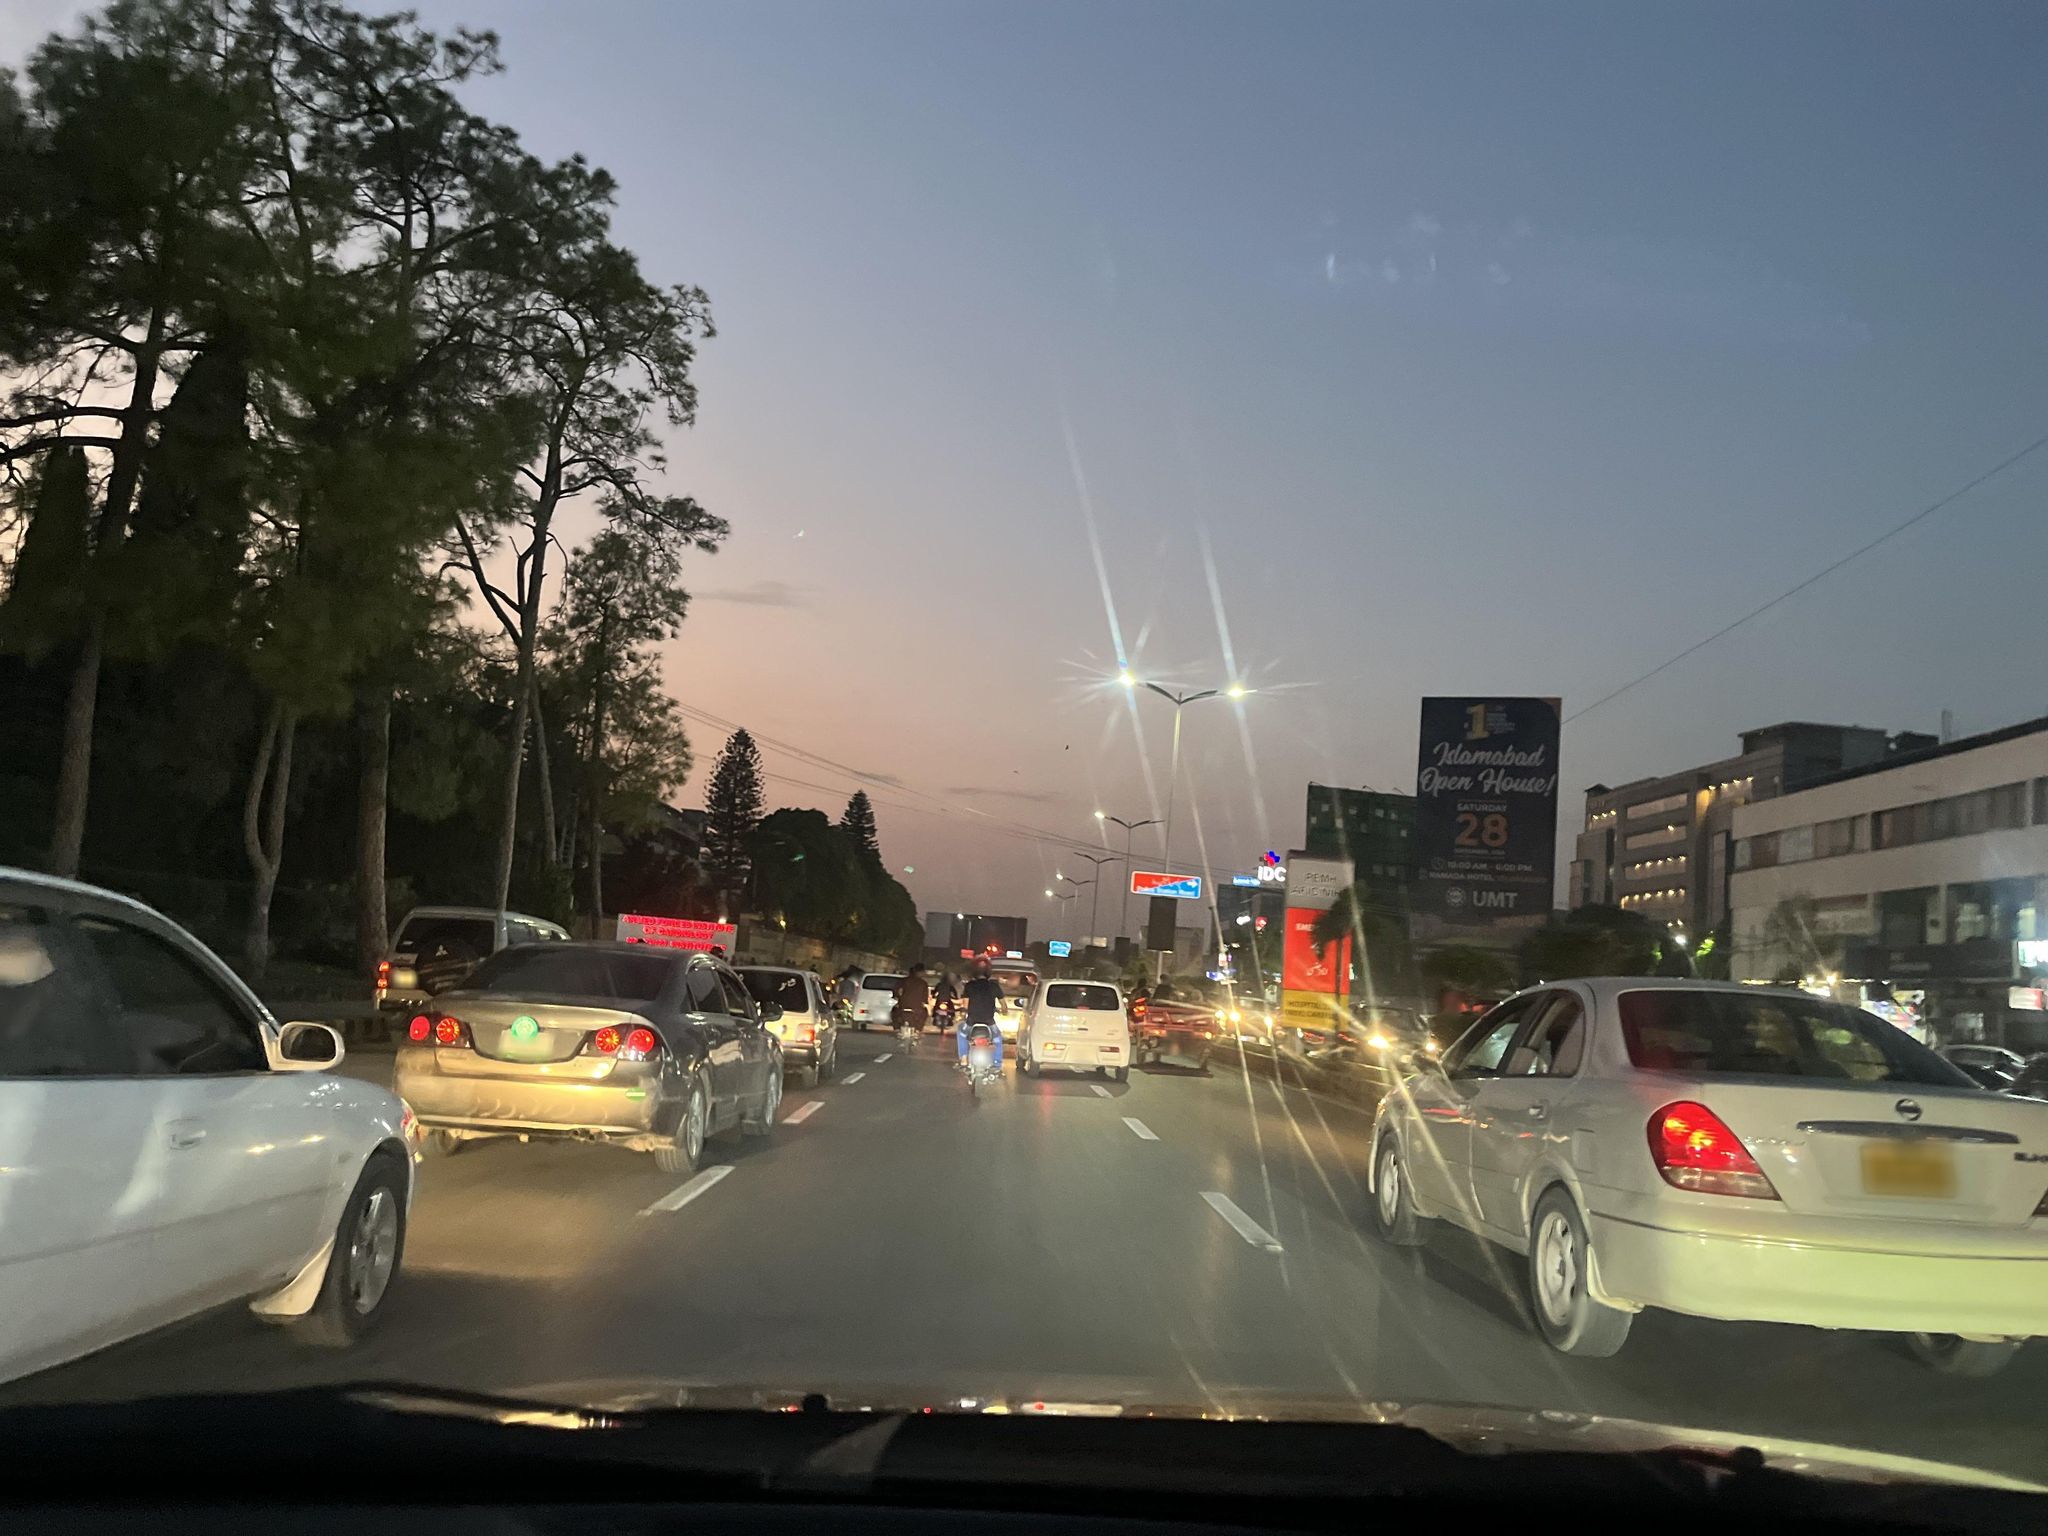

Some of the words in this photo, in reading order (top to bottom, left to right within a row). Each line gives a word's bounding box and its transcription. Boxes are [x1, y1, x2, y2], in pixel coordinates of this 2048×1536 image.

[1433, 742, 1545, 767] Islamabad
[1420, 767, 1474, 798] Open
[1478, 768, 1557, 797] House!
[1457, 803, 1507, 813] SATURDAY
[1454, 813, 1508, 848] 28
[1257, 866, 1287, 882] IDC
[1472, 890, 1518, 908] UMT
[643, 925, 656, 934] OF
[693, 920, 734, 933] INSTITUTE
